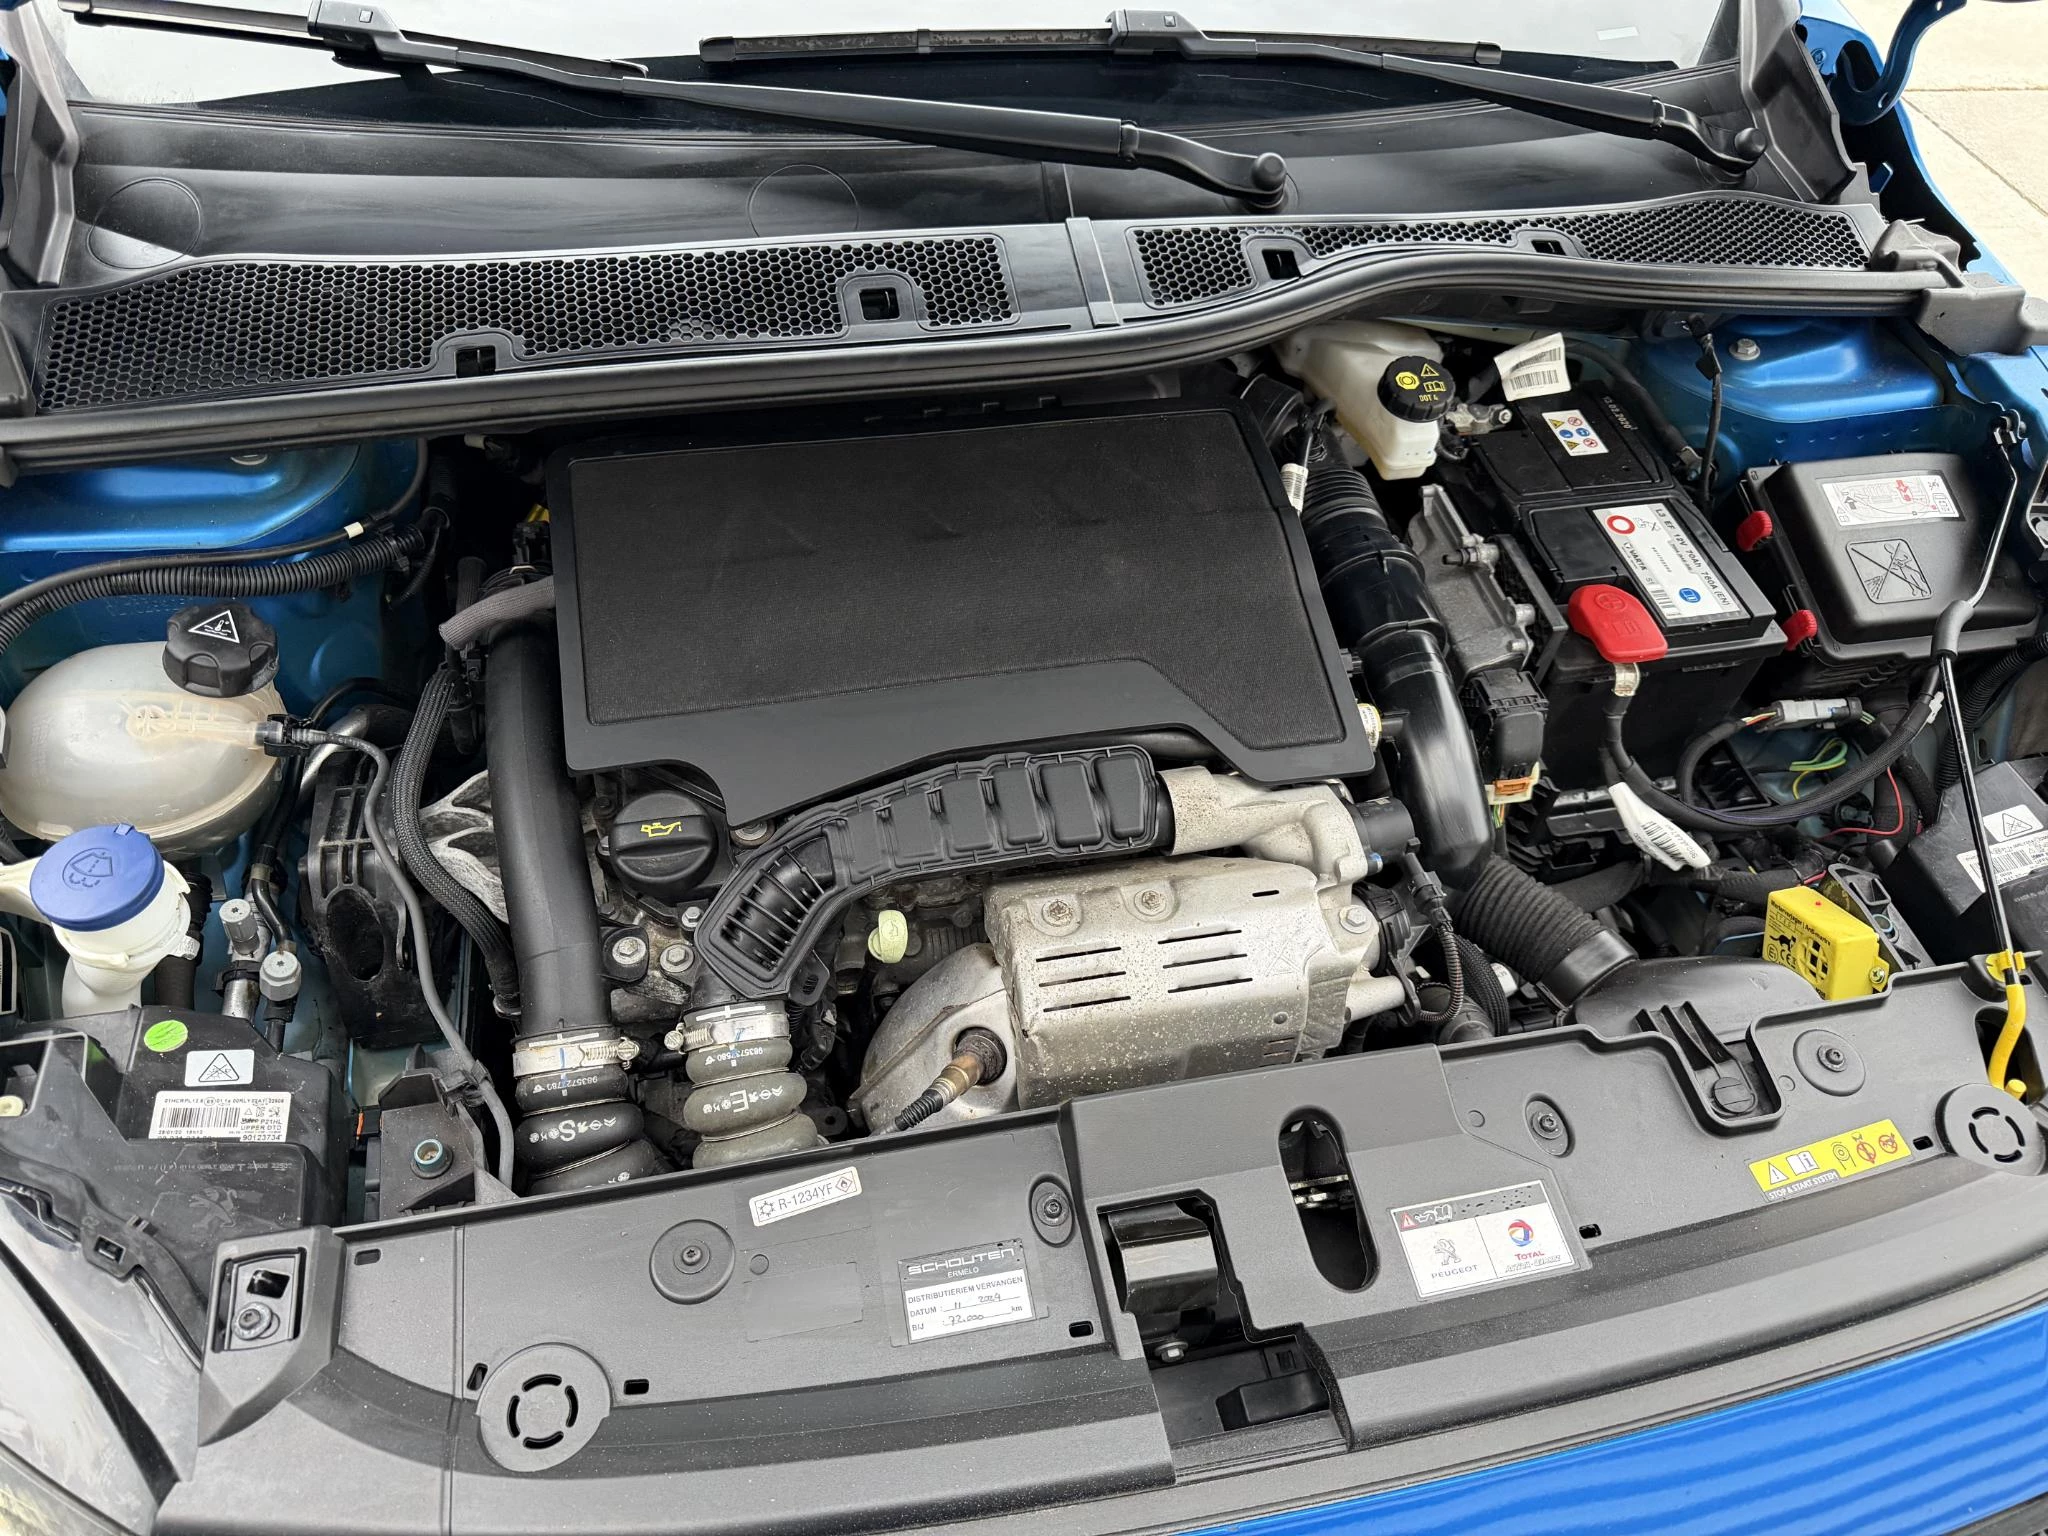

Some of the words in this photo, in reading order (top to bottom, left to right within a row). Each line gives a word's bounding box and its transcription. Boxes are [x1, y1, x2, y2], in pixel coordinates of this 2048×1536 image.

[1418, 394, 1432, 402] DOT
[1630, 547, 1648, 571] VARTA
[1655, 508, 1666, 518] L3
[1664, 520, 1675, 530] EF
[1673, 533, 1688, 547] 12V
[1685, 549, 1702, 568] 70Ah
[1701, 571, 1718, 590] 760A
[1715, 589, 1730, 606] (EN)
[1768, 1186, 1787, 1200] STOP
[1792, 1178, 1814, 1192] START
[1813, 1171, 1839, 1186] SYSTEM
[777, 1183, 834, 1212] R-1234YF
[907, 1248, 1015, 1276] SCHOUTEN
[1514, 1250, 1545, 1261] TOTAL
[947, 1266, 979, 1279] ERMELO
[1431, 1264, 1479, 1280] PEUGEOT
[907, 1286, 975, 1305] DISTRIBUTIERIEM
[974, 1275, 1024, 1293] VERVANGEN
[909, 1305, 938, 1318] DATUM
[1010, 1303, 1024, 1314] km
[911, 1322, 925, 1332] BIJ
